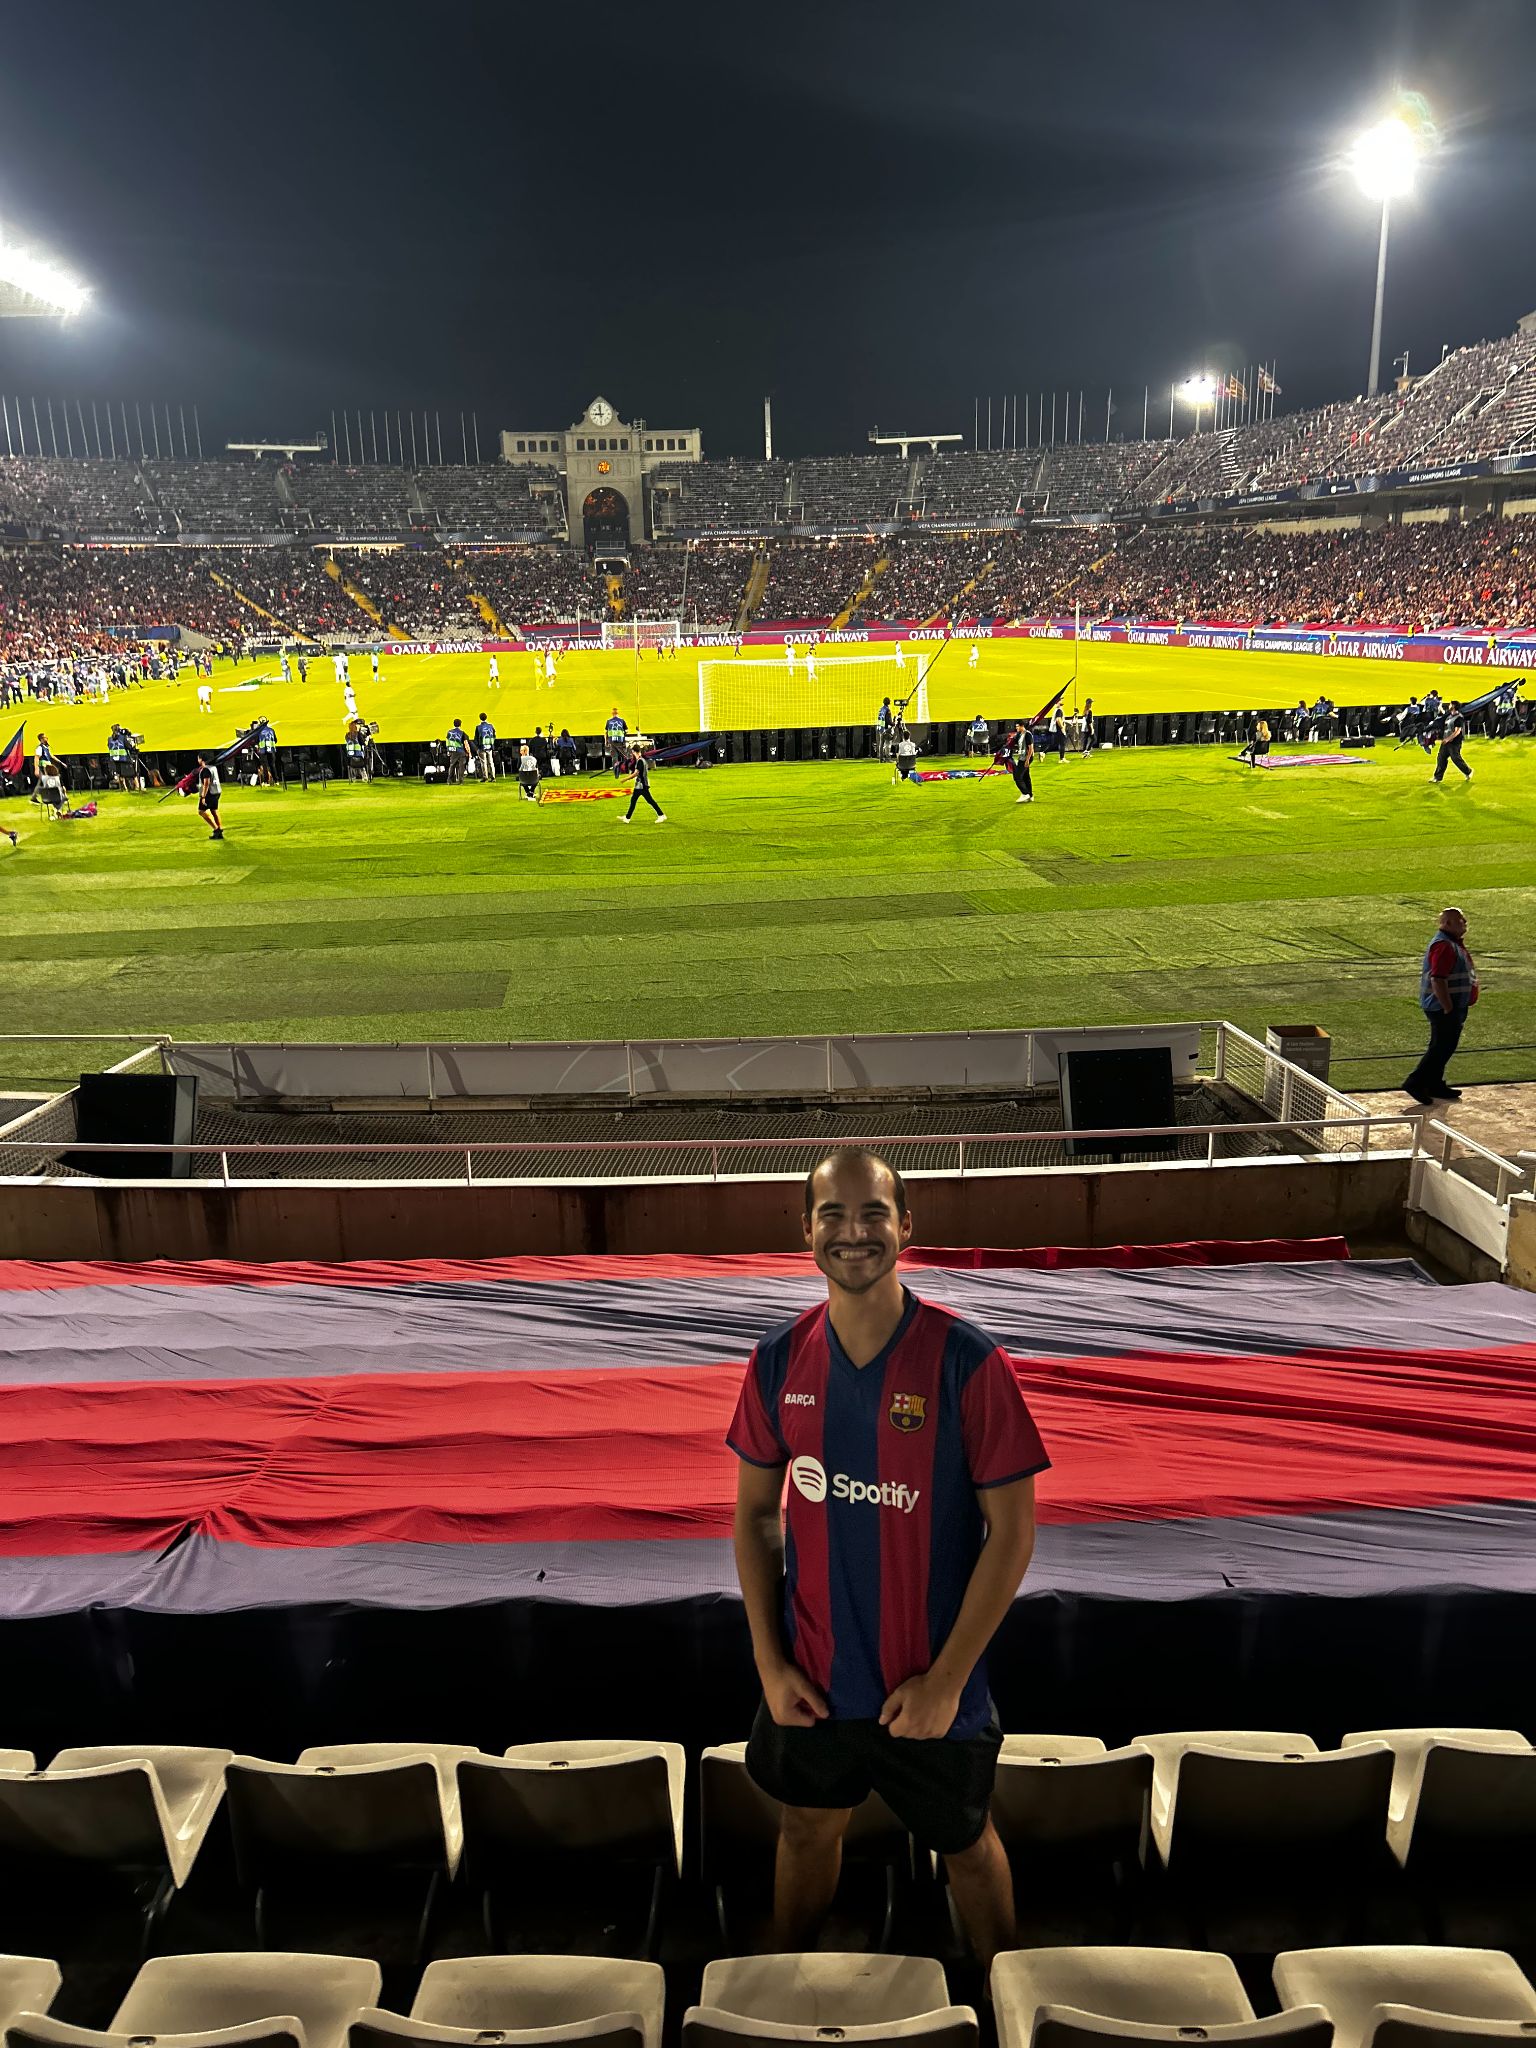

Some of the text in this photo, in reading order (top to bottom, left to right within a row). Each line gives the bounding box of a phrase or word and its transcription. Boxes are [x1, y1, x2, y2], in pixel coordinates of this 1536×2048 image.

[784, 631, 869, 645] QATAR AIRWAYS
[909, 627, 993, 641] QATAR AIRWAYS
[1127, 631, 1145, 644] QATAR
[391, 641, 483, 655] QATAR AIRWAYS
[567, 639, 615, 650] AIRWAYS
[1189, 634, 1240, 650] QATAR AIRWAYS
[1252, 639, 1314, 652] UEFA CHAMPIONS LEAGUE
[1329, 640, 1404, 659] QATAR AIRWAYS
[1443, 645, 1483, 664] QATAR
[784, 1393, 816, 1407] BARÇA
[832, 1473, 920, 1513] Spotify
